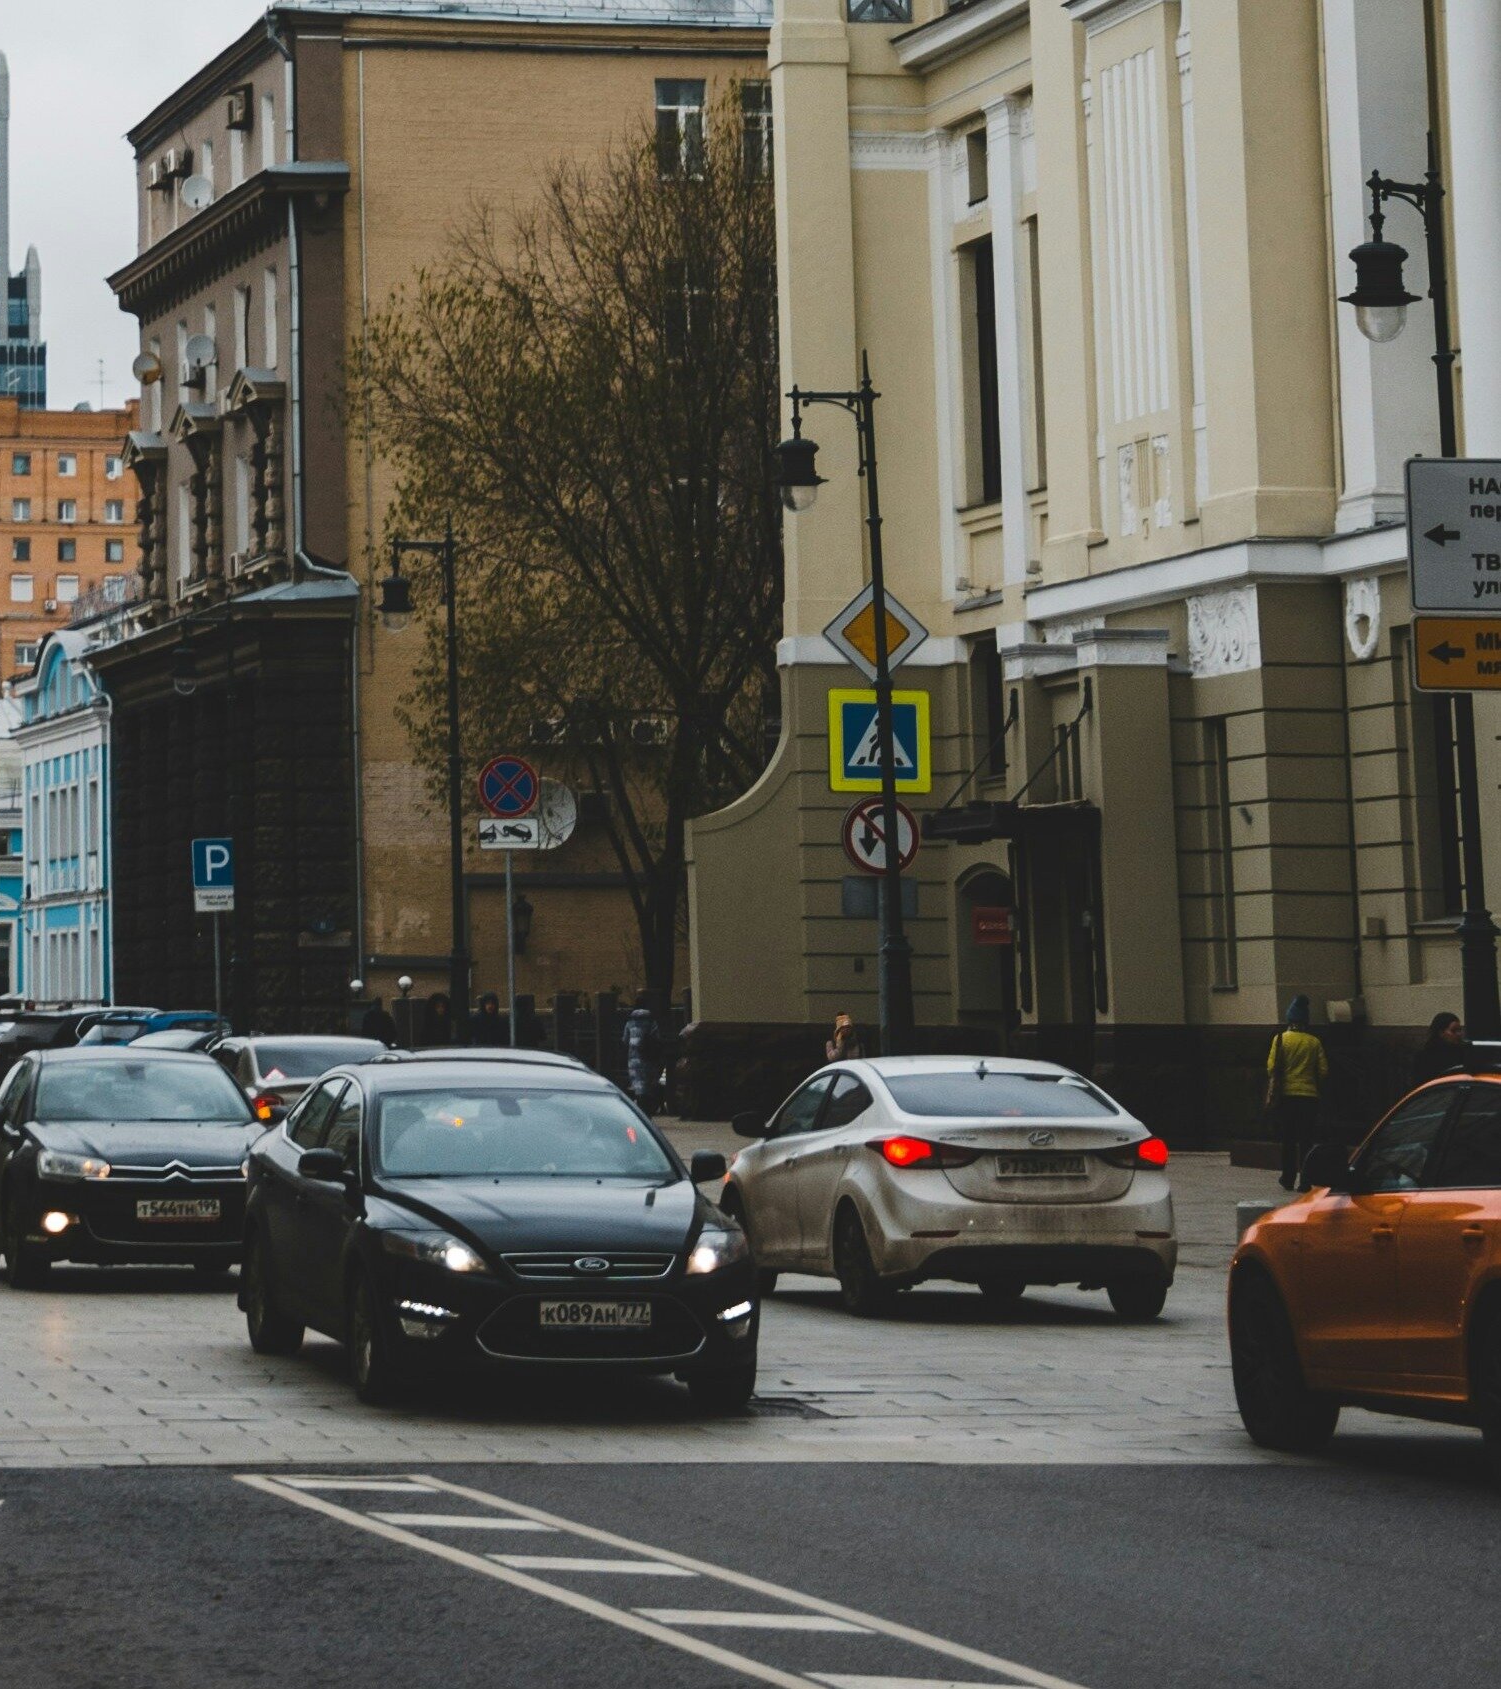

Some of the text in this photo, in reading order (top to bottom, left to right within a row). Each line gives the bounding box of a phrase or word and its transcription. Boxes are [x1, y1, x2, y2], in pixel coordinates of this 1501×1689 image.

[1469, 477, 1501, 495] НА
[1473, 581, 1501, 598] ул
[205, 844, 230, 882] P
